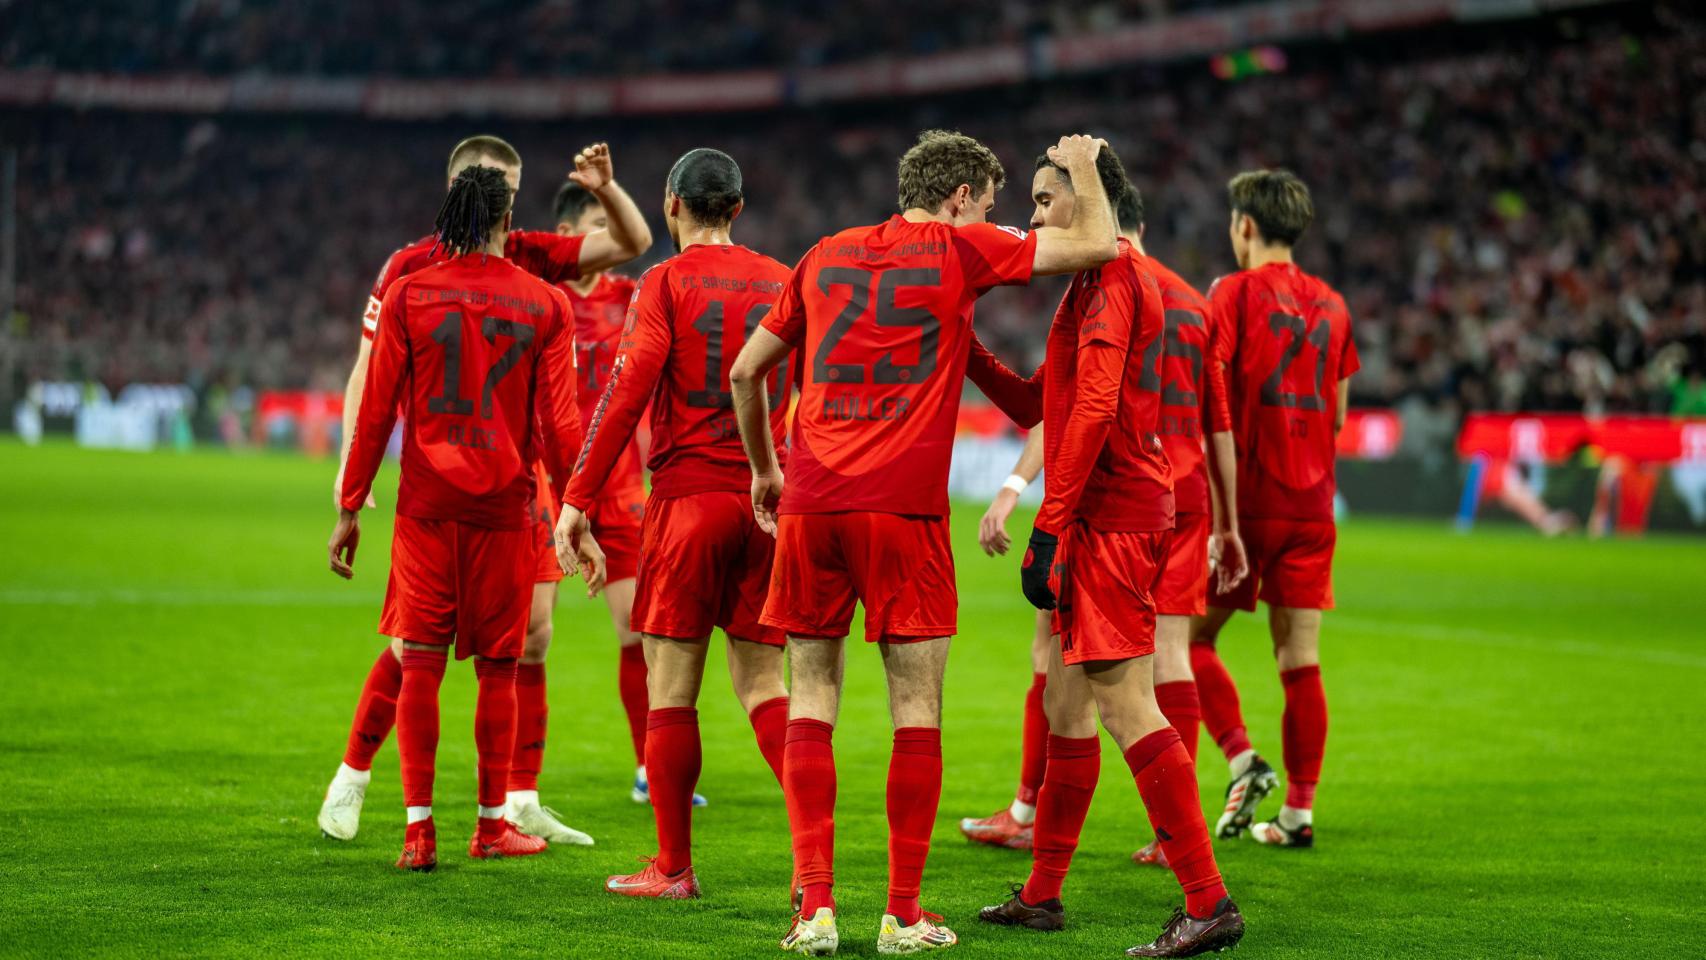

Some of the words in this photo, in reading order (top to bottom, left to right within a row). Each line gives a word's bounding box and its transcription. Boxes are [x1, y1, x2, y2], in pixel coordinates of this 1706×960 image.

[682, 276, 698, 289] FC
[702, 276, 747, 291] BAYERN
[812, 266, 941, 384] 25
[428, 311, 535, 420] 17
[1260, 311, 1331, 413] 21
[448, 423, 497, 451] OLISE
[824, 391, 910, 422] MÜLLER
